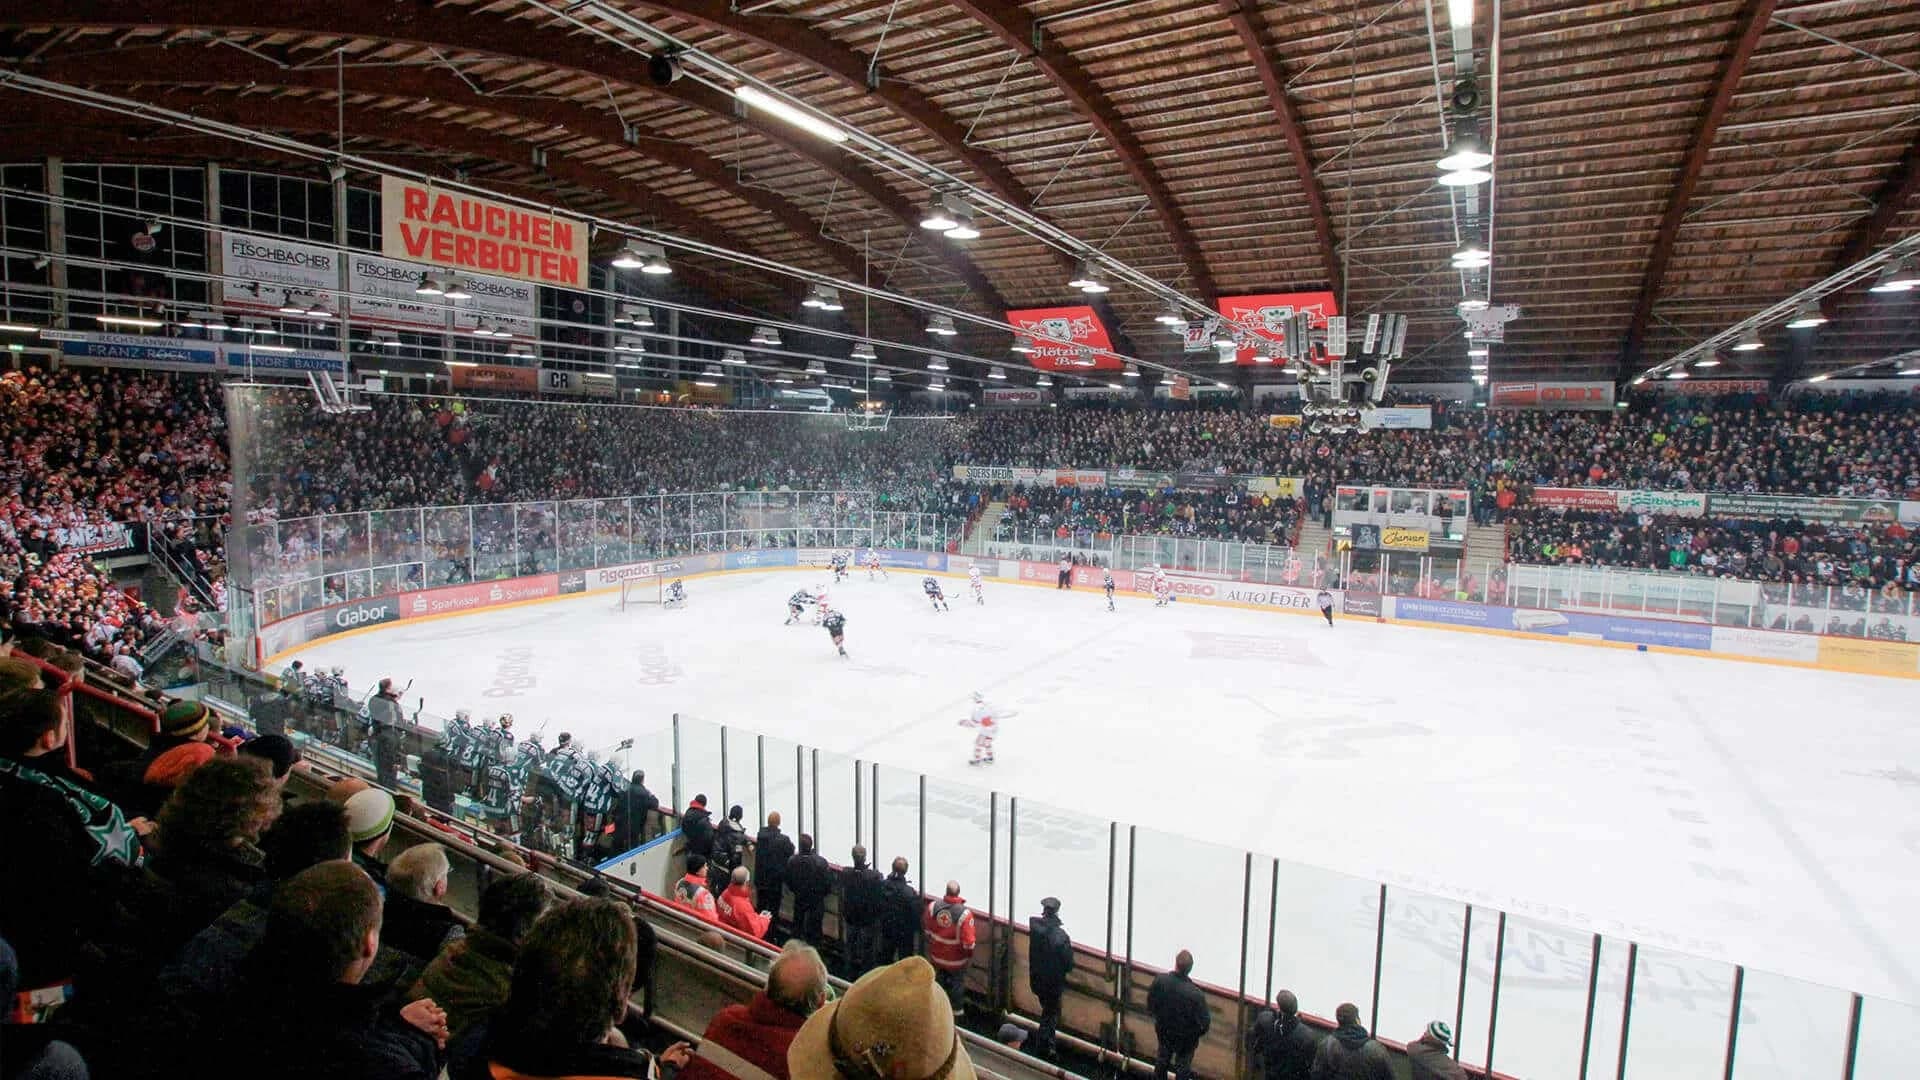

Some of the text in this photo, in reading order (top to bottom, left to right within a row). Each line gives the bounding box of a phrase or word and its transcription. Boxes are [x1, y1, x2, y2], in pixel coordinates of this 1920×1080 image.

[404, 187, 573, 251] RAUCHEN
[232, 242, 331, 268] FISCHBACHER
[400, 222, 579, 286] VERBOTEN
[88, 345, 141, 358] FRANZ
[551, 373, 568, 388] CR
[432, 597, 480, 610] Sparkasse
[1228, 589, 1265, 604] AUTO
[1269, 590, 1311, 609] EDER
[336, 605, 387, 627] Gabor
